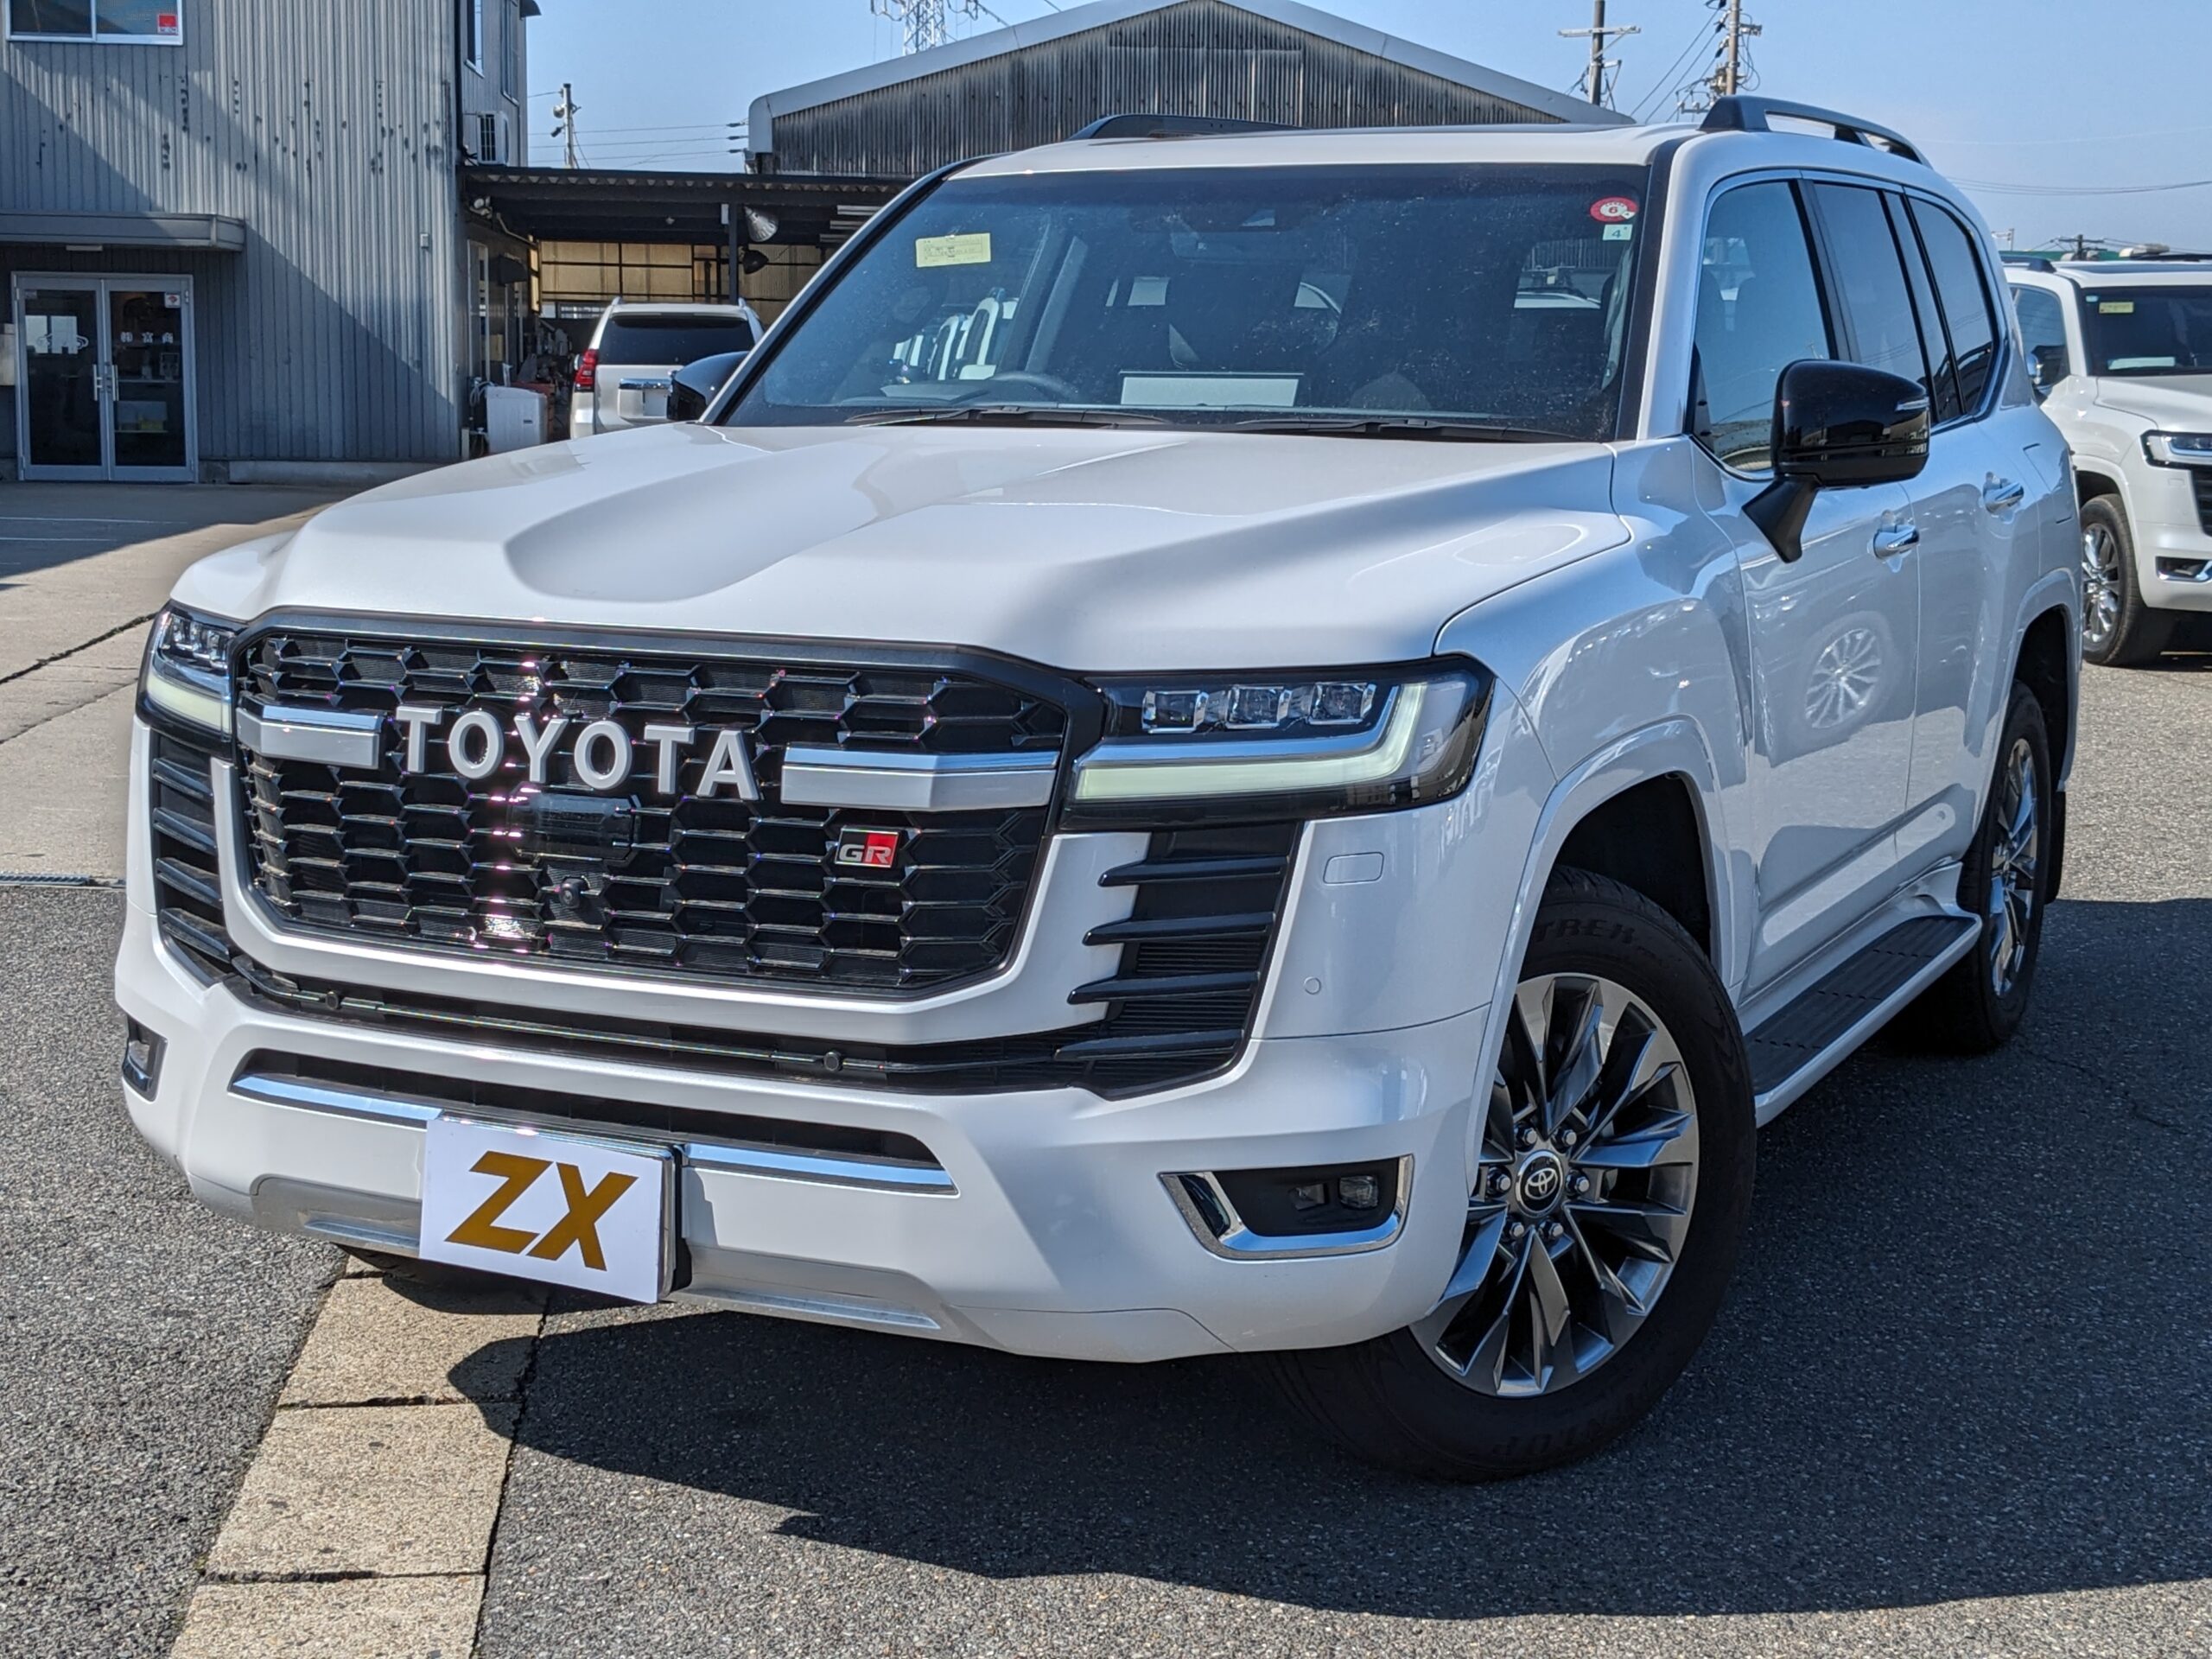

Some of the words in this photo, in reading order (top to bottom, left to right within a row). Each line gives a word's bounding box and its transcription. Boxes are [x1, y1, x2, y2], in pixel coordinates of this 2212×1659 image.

[396, 706, 761, 801] TOYOTA
[839, 843, 892, 865] GR
[444, 1150, 639, 1272] ZX
